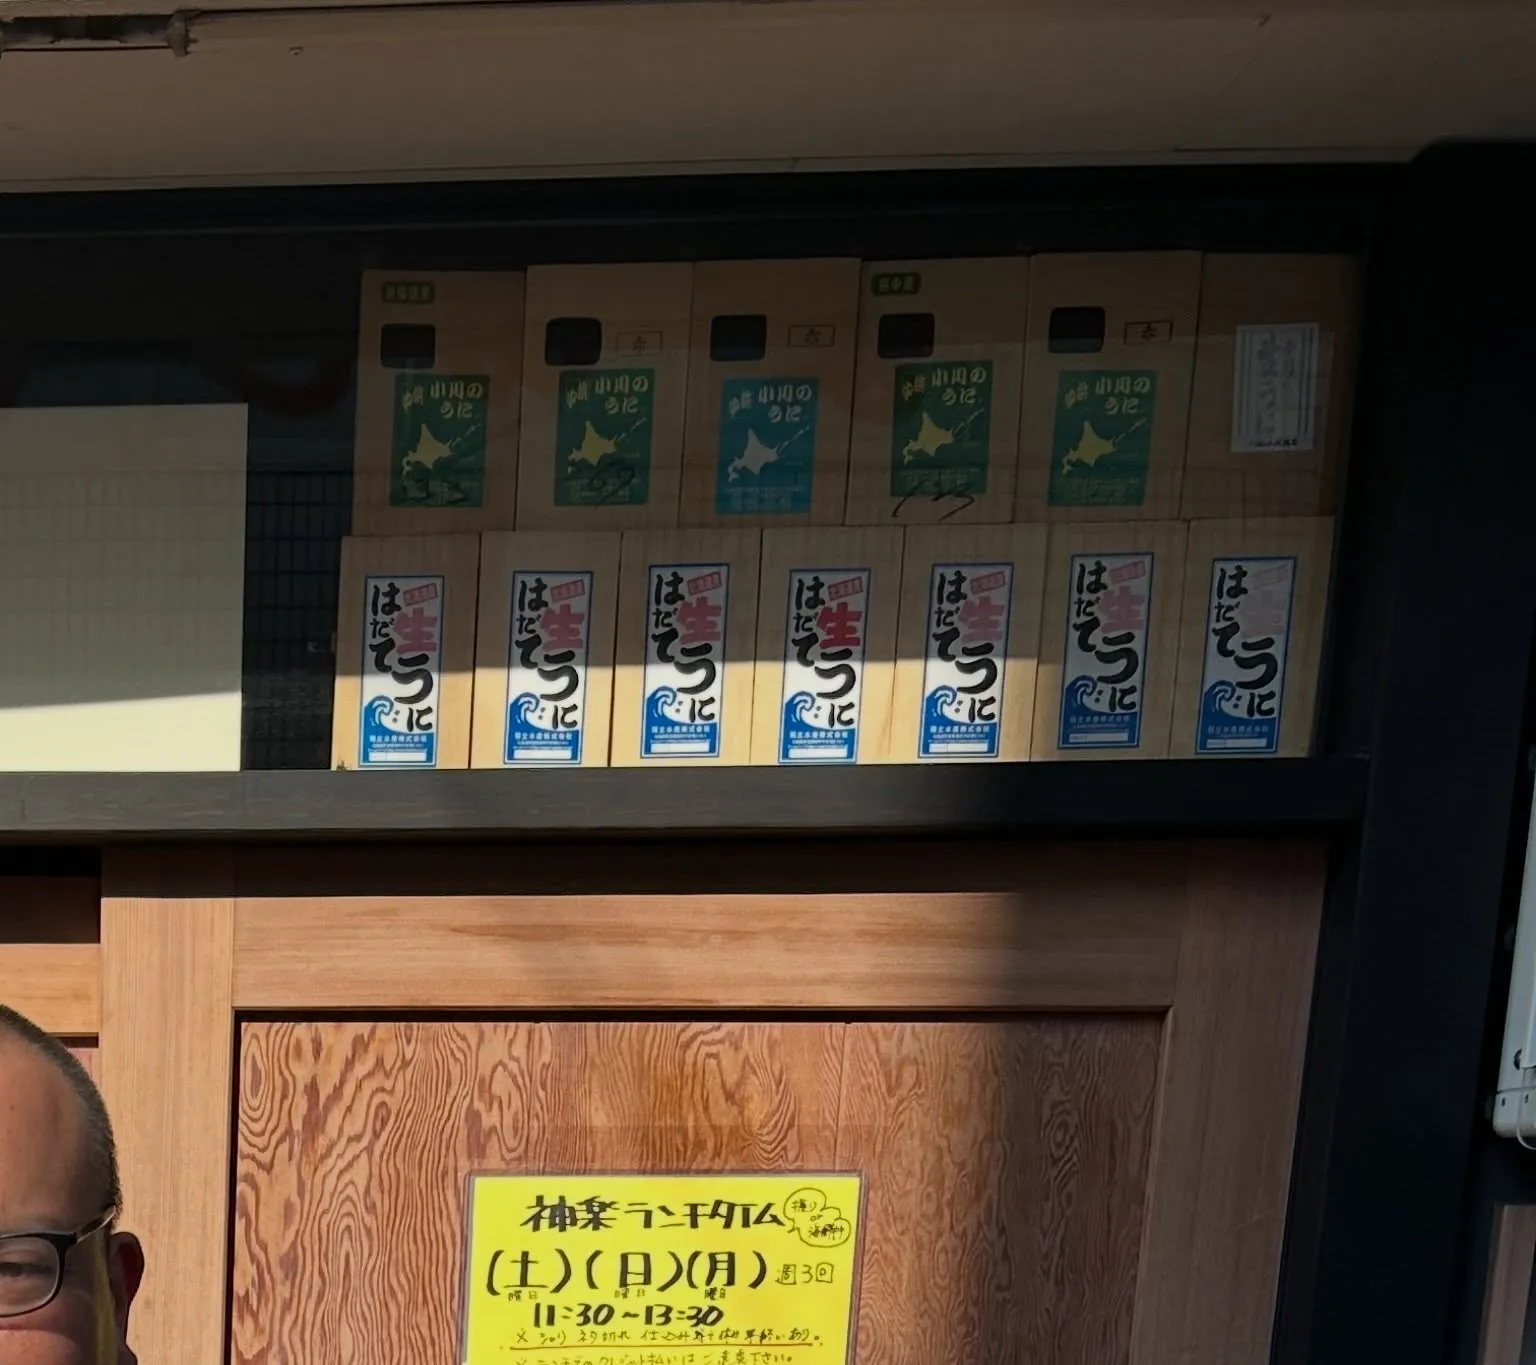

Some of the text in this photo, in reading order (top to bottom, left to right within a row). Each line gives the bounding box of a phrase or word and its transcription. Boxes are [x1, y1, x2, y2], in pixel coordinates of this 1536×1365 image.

[430, 381, 483, 400] 小川の
[440, 402, 473, 420] うに
[595, 376, 649, 394] 小川の
[605, 396, 638, 415] うに
[758, 383, 812, 404] 小川の
[767, 404, 801, 423] うに
[931, 366, 987, 387] 小川の
[942, 388, 977, 405] うに
[1095, 376, 1150, 393] 小川の
[1104, 396, 1139, 415] うに
[368, 582, 402, 673] はだて
[514, 577, 548, 669] はだて
[651, 571, 686, 664] はだて
[791, 576, 826, 667] はだて
[932, 571, 967, 661] はだて
[1072, 560, 1108, 652] はだて
[1094, 586, 1146, 713] 生うに
[1212, 565, 1249, 658] はだて
[392, 607, 439, 732] 生うに
[537, 603, 585, 730] 生うに
[673, 596, 722, 724] 生うに
[814, 602, 863, 728] 生うに
[955, 595, 1005, 722] 生うに
[519, 1194, 785, 1232] 神楽ランチタイム
